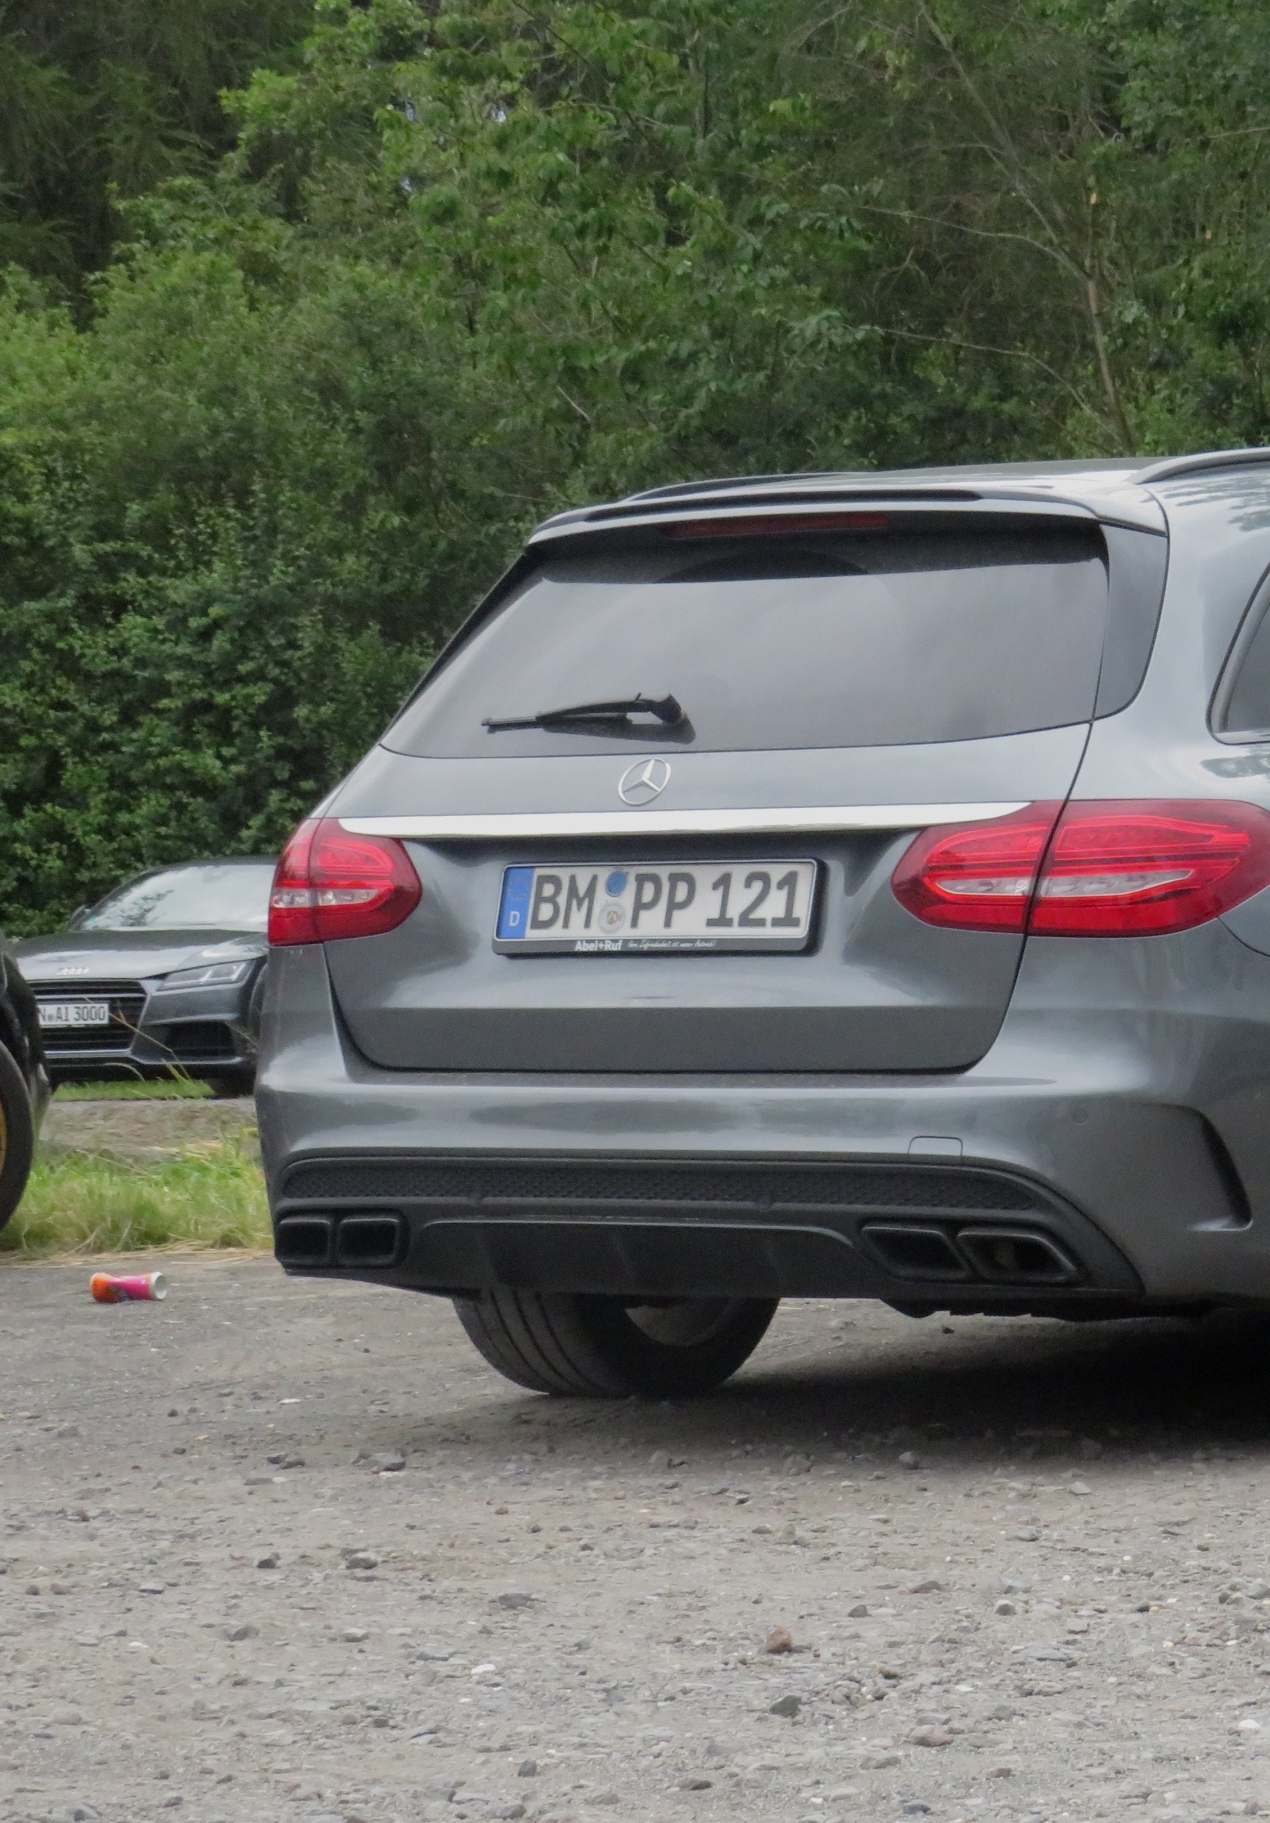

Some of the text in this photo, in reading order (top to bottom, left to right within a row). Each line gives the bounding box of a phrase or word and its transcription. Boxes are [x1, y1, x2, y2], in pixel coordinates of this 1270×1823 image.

[530, 870, 800, 930] BM PP 121
[509, 911, 520, 927] D
[574, 939, 623, 951] Abel+Ruf
[56, 1006, 70, 1021] AI
[73, 1005, 106, 1021] 3000
